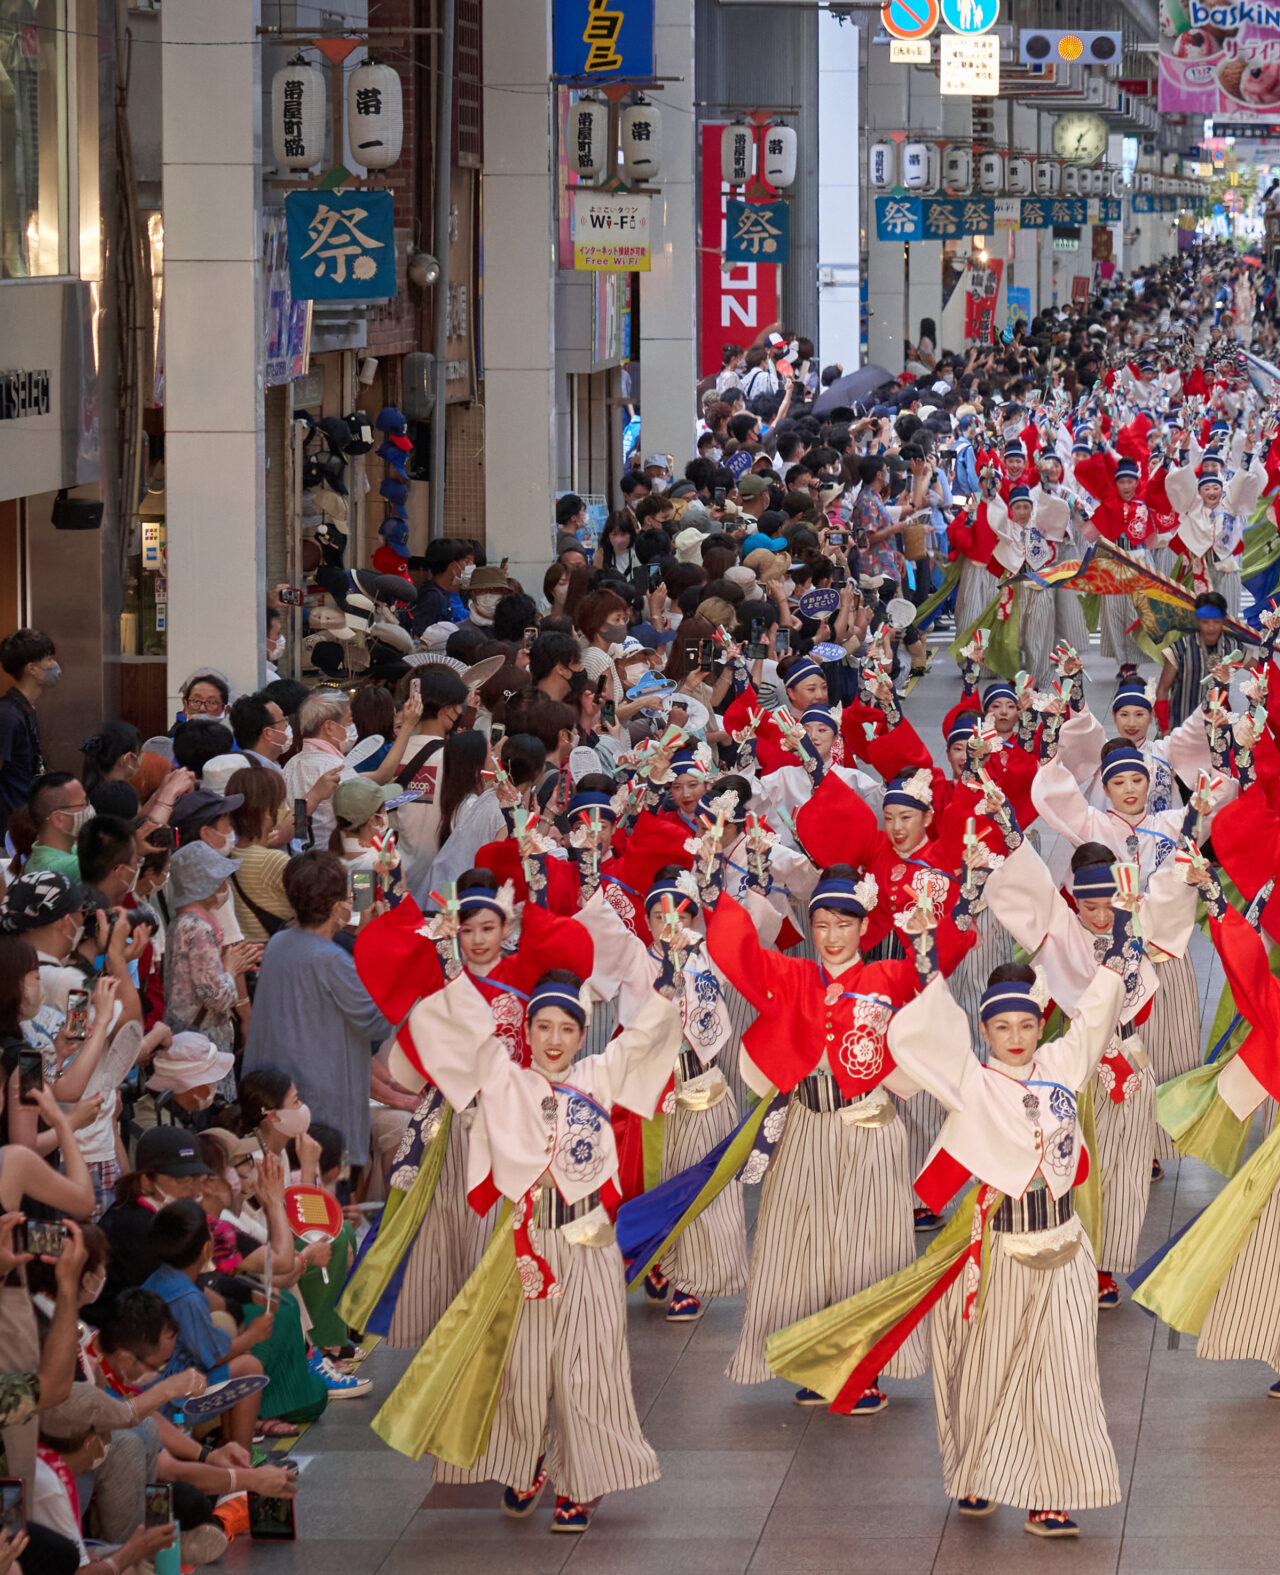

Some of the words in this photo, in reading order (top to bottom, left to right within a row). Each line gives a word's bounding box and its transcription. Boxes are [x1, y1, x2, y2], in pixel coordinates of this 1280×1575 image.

[1192, 2, 1280, 28] baskin
[283, 80, 305, 158] 帯屋町筋
[356, 88, 383, 149] 帯一
[577, 112, 593, 168] 帯屋町筋
[632, 121, 651, 165] 帯一
[734, 134, 746, 178] 帯屋町筋
[769, 140, 783, 174] 帯一
[590, 206, 638, 214] よさこいタウン
[590, 214, 636, 230] Wi-Fi
[882, 201, 917, 233] 祭
[926, 203, 959, 234] 祭
[962, 202, 990, 230] 祭
[1022, 202, 1045, 224] 祭
[1051, 202, 1071, 222] 祭
[300, 204, 385, 284] 祭
[733, 208, 783, 254] 祭
[585, 257, 609, 265] Free
